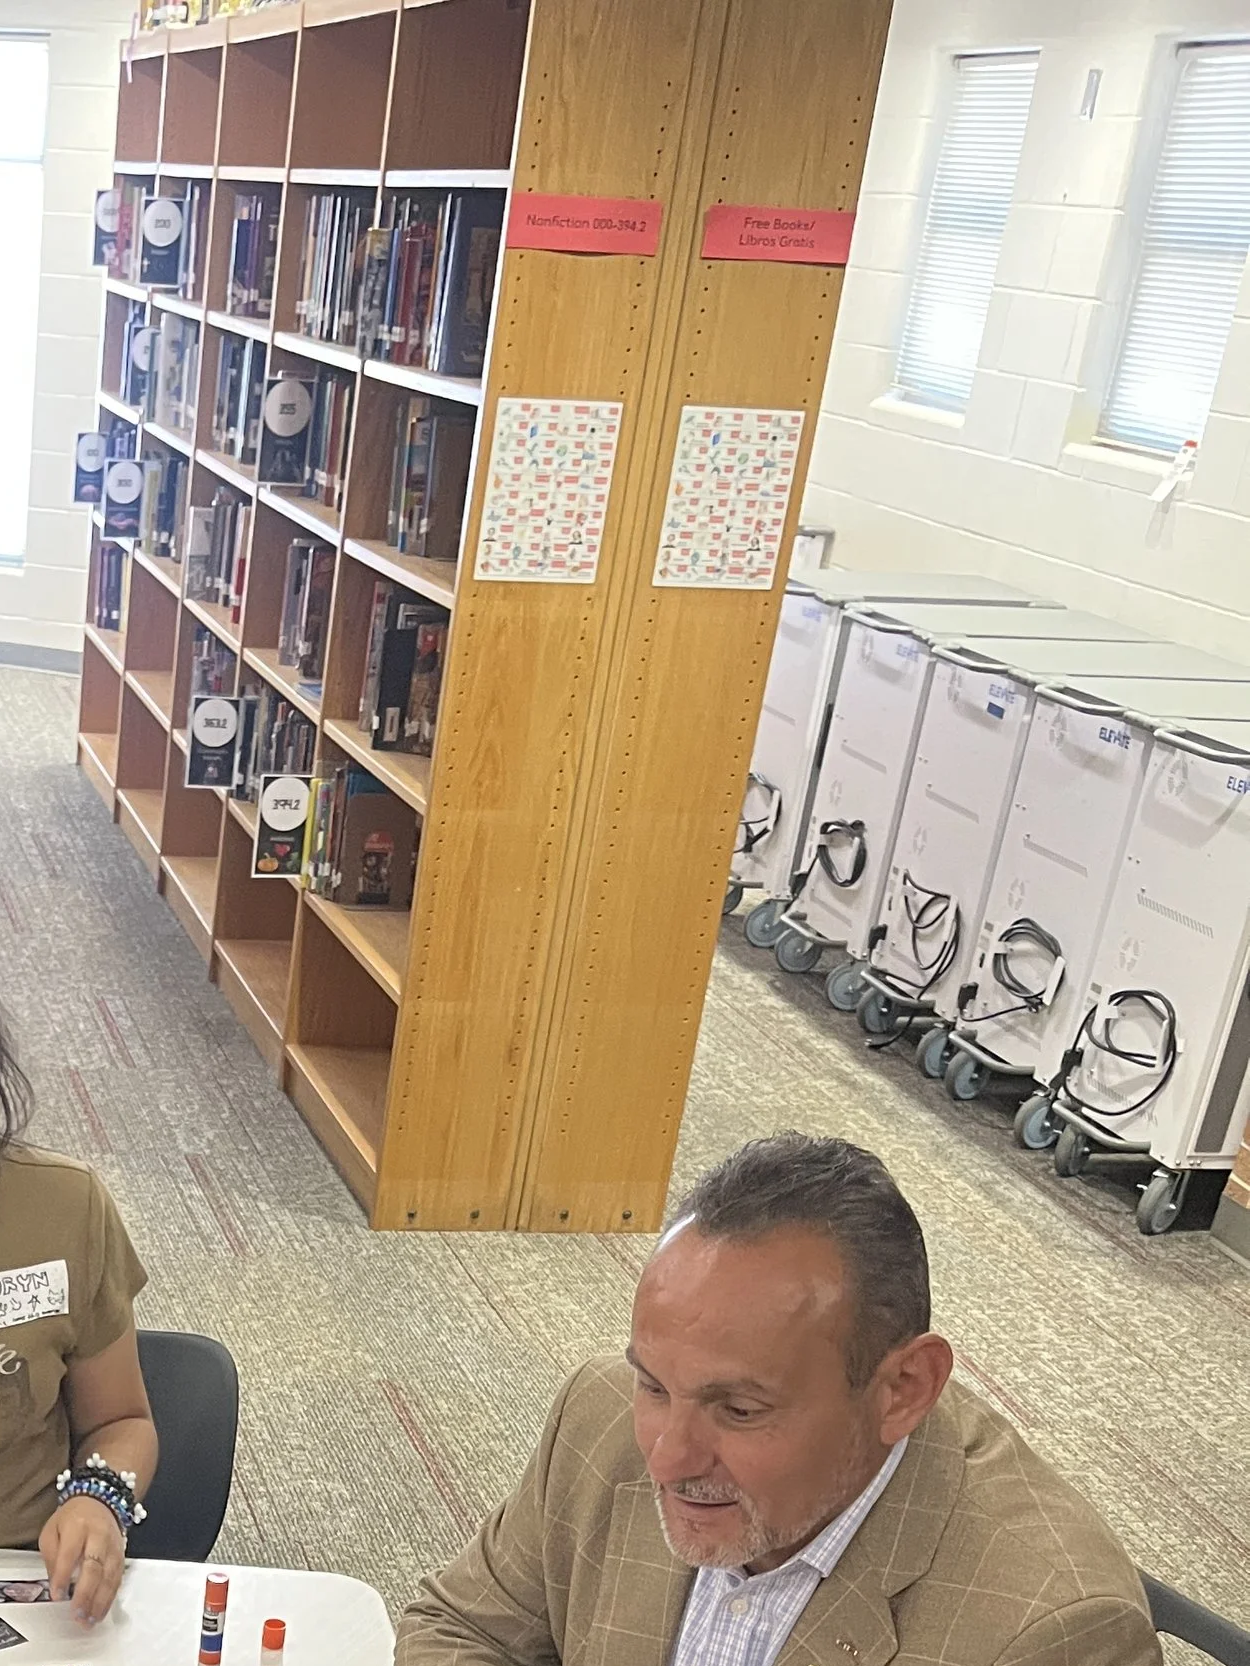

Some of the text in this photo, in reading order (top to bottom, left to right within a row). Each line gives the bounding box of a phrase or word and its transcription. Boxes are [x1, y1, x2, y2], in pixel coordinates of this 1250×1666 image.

[526, 214, 647, 233] Nonfiction 000-394.2
[743, 217, 771, 231] Free
[739, 234, 815, 249] Libros Gratis
